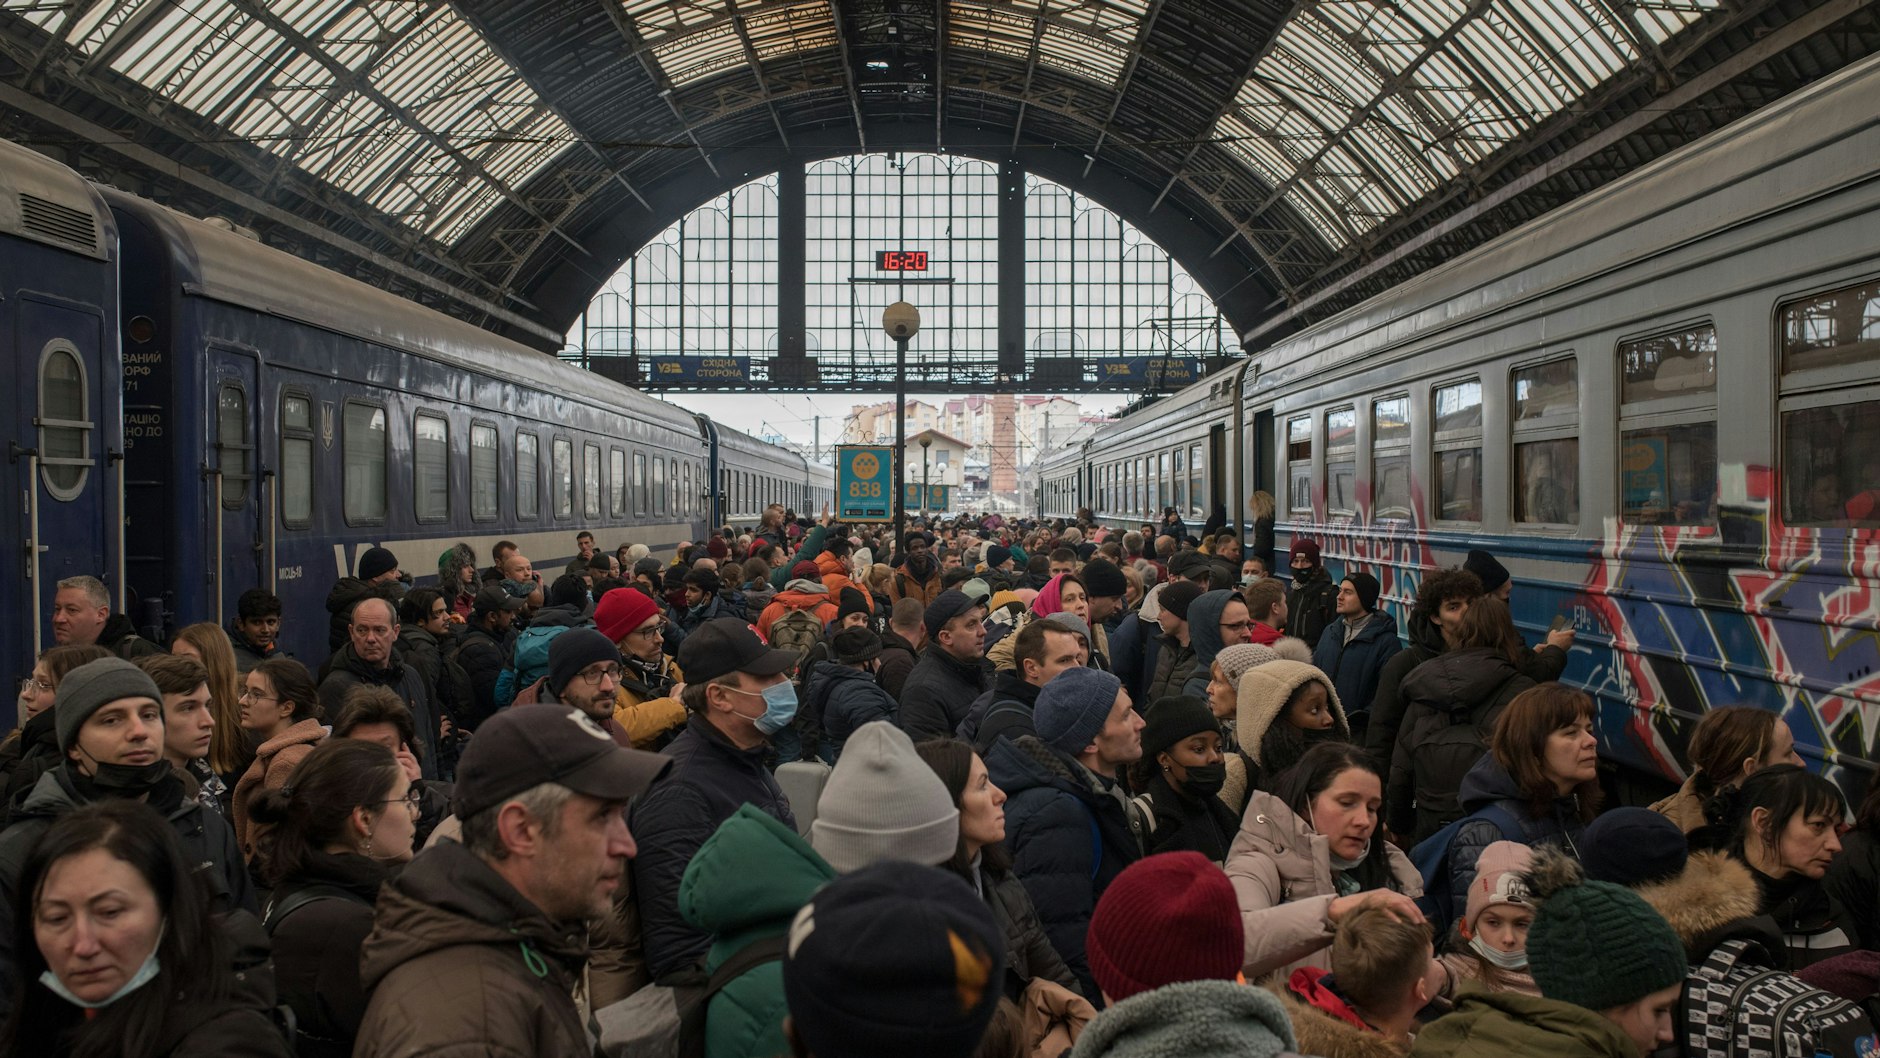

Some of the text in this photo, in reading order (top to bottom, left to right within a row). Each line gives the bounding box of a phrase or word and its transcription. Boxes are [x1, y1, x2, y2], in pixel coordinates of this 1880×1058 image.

[884, 252, 926, 270] 16:20
[702, 359, 737, 368] СХІДНА
[122, 366, 151, 376] ОРФ
[696, 369, 742, 377] СТОРОНА
[145, 427, 163, 437] ДО
[849, 482, 881, 498] 838
